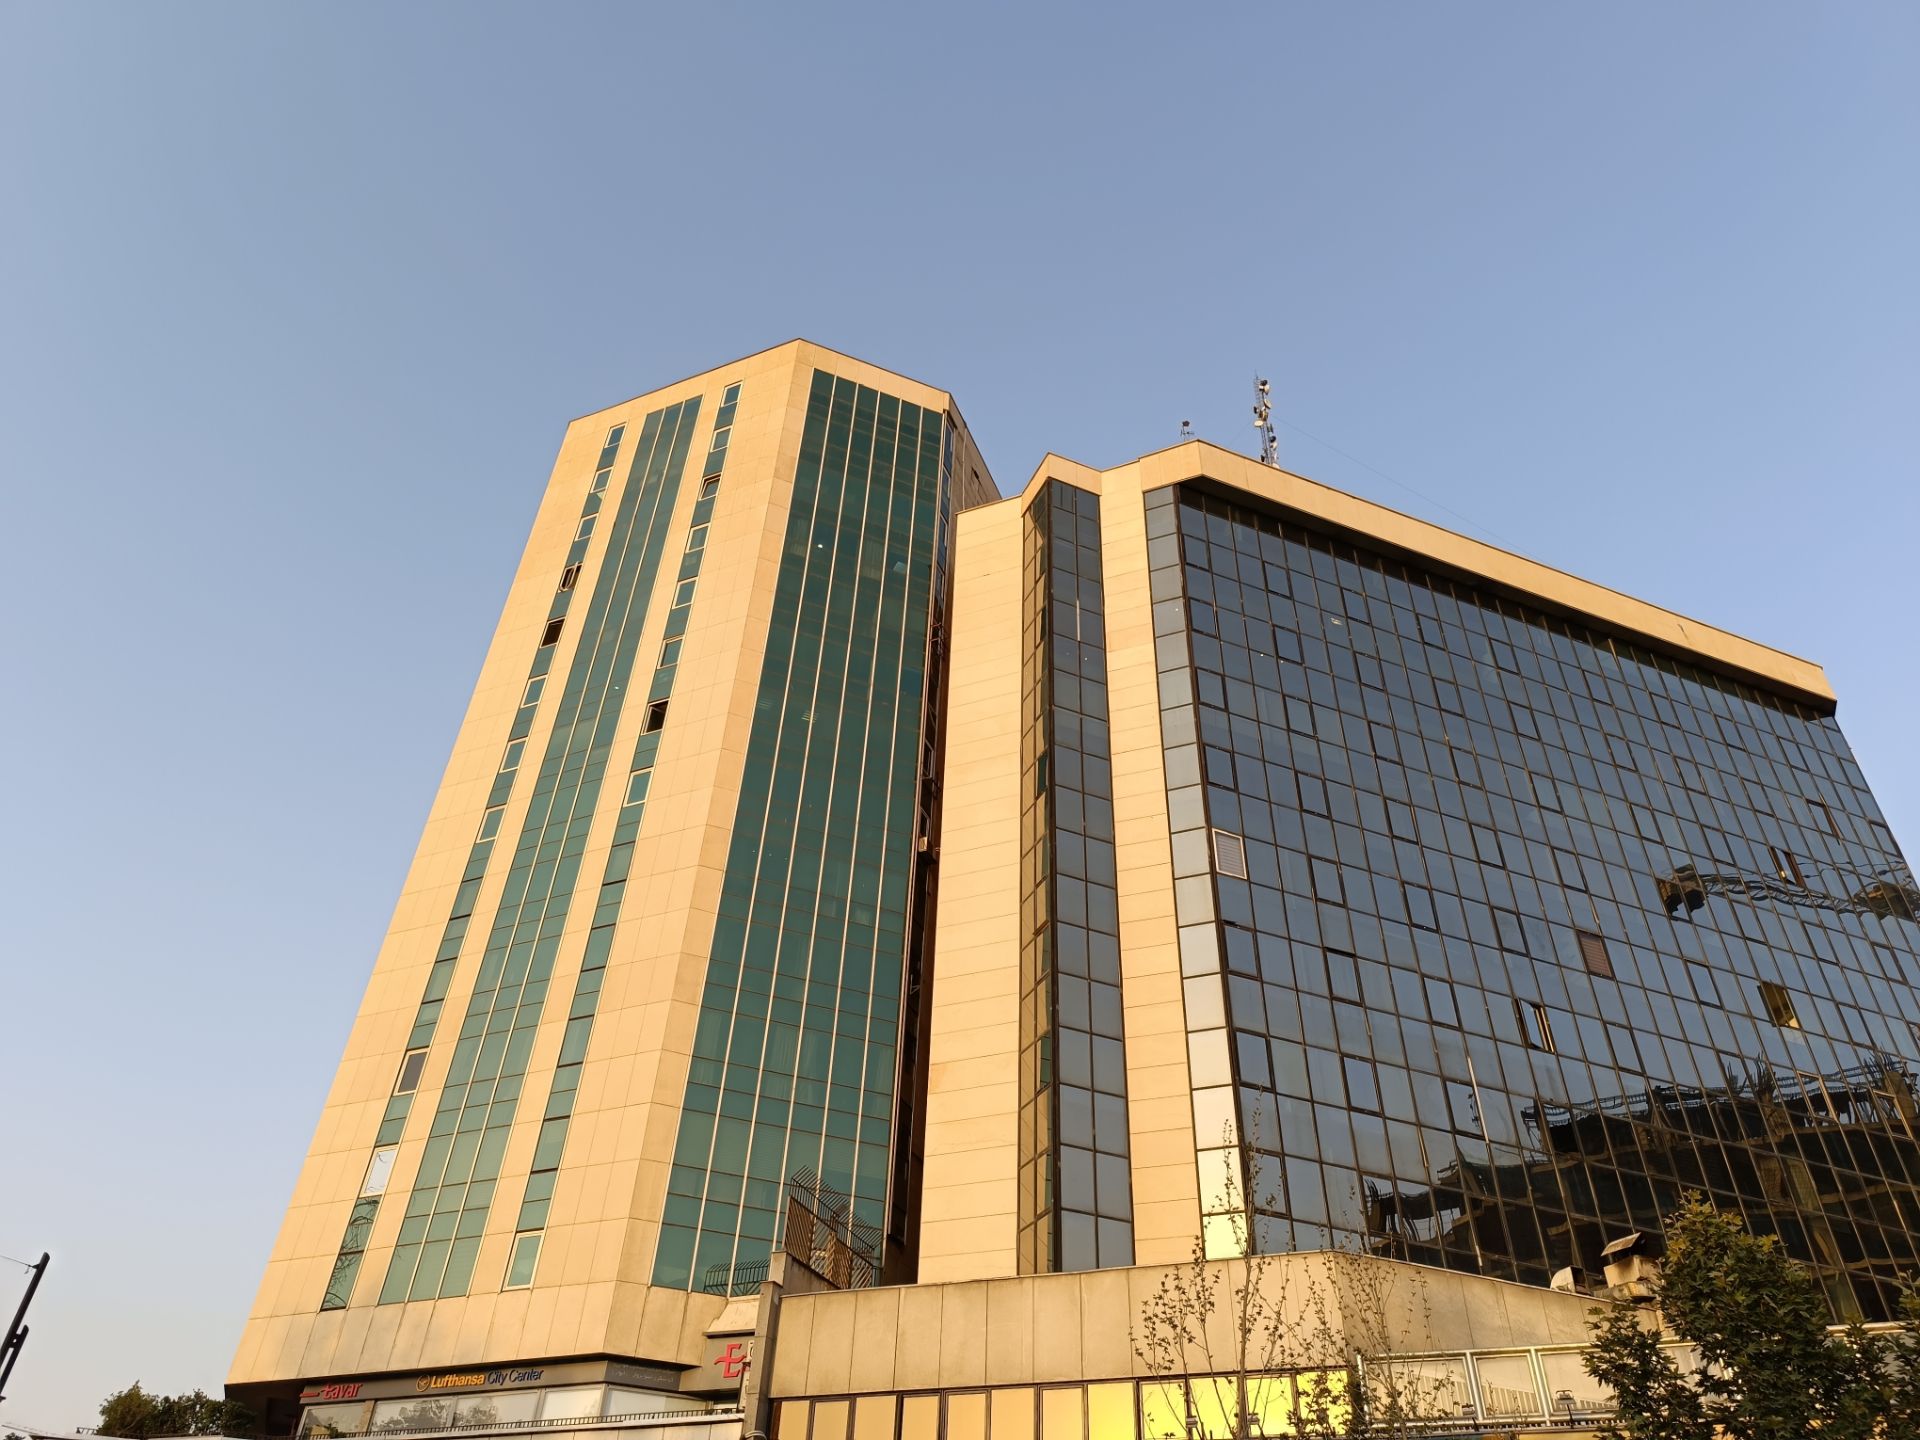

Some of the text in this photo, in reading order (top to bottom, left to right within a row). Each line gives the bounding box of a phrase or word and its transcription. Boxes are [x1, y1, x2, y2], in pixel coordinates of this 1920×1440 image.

[431, 1369, 544, 1389] Lufthansa City Center
